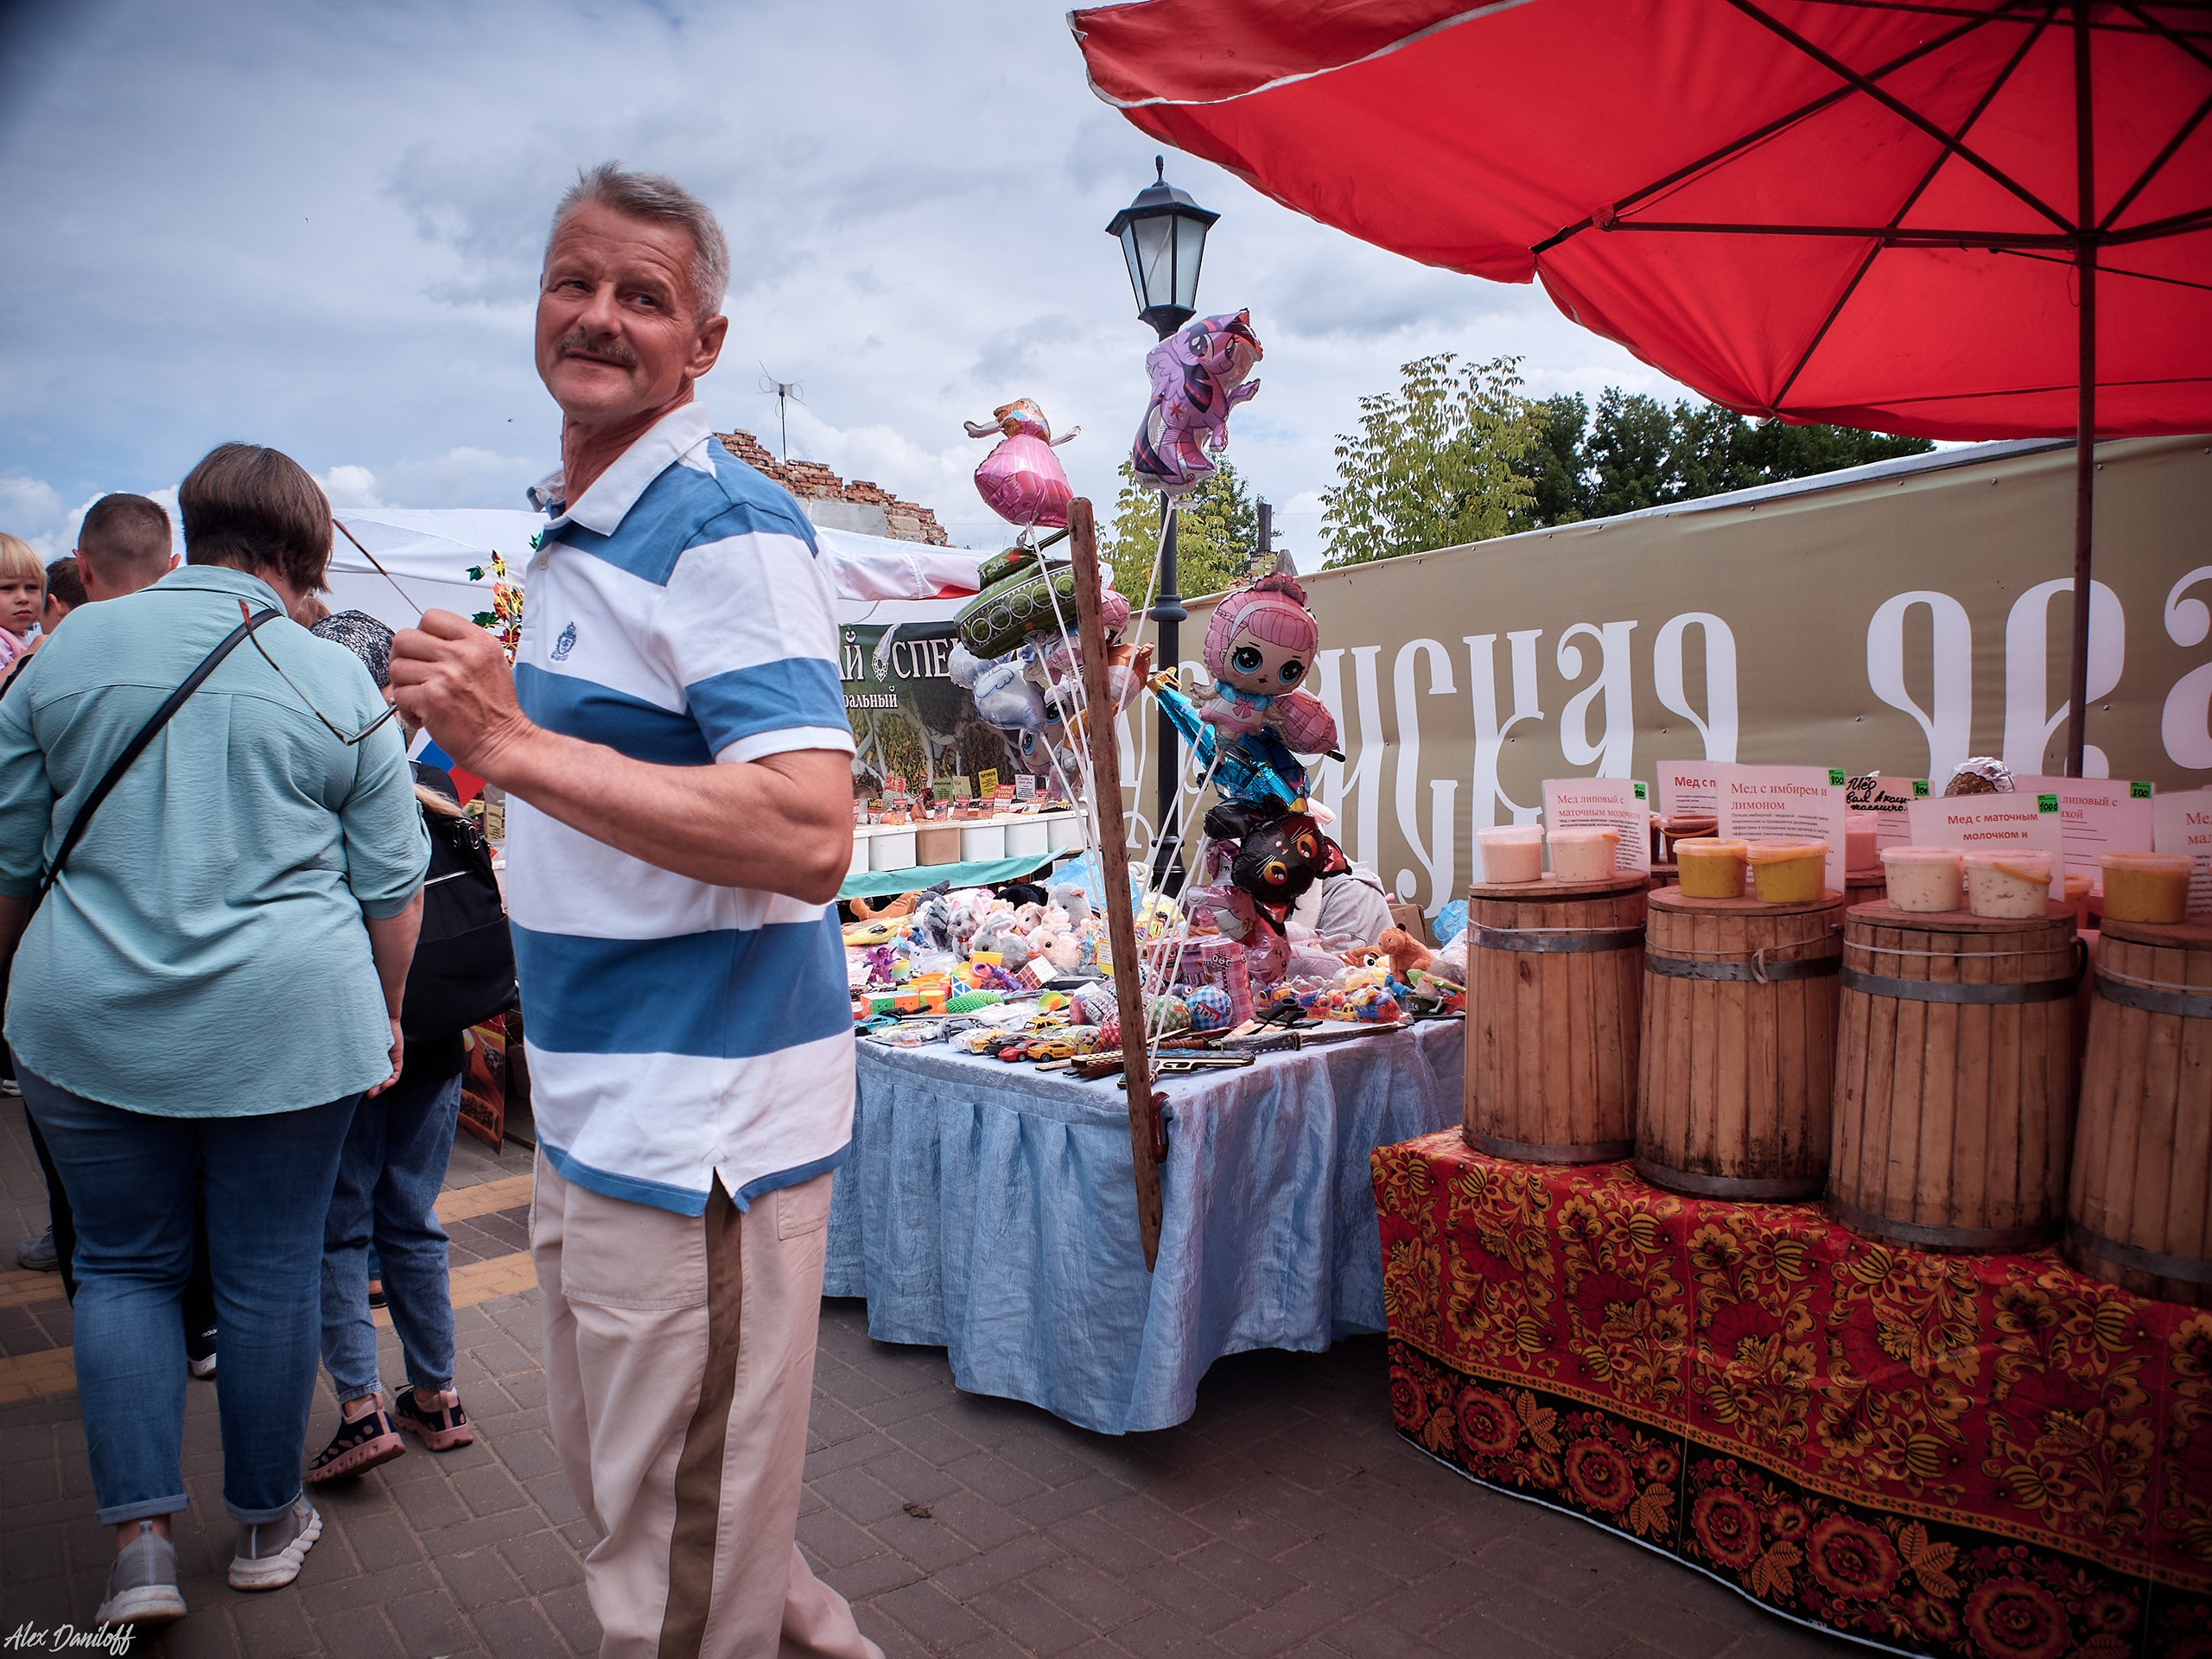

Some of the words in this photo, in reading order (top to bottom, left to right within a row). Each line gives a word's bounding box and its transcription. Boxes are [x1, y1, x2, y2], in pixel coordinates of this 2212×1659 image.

[892, 637, 961, 679] СПЕ
[1675, 776, 1700, 788] Мед
[1731, 783, 1757, 795] Мед
[1770, 783, 1818, 797] имбирем
[1821, 788, 1827, 797] и
[1557, 795, 1578, 805] Мед
[1580, 794, 1618, 804] липовый
[2062, 796, 2109, 807] липовый
[1731, 802, 1785, 810] лимоном
[1607, 810, 1641, 820] молочком
[1947, 815, 1973, 825] Мед
[1983, 812, 2038, 823] маточным
[2185, 812, 2212, 826] Ме
[1962, 830, 2019, 841] молочком
